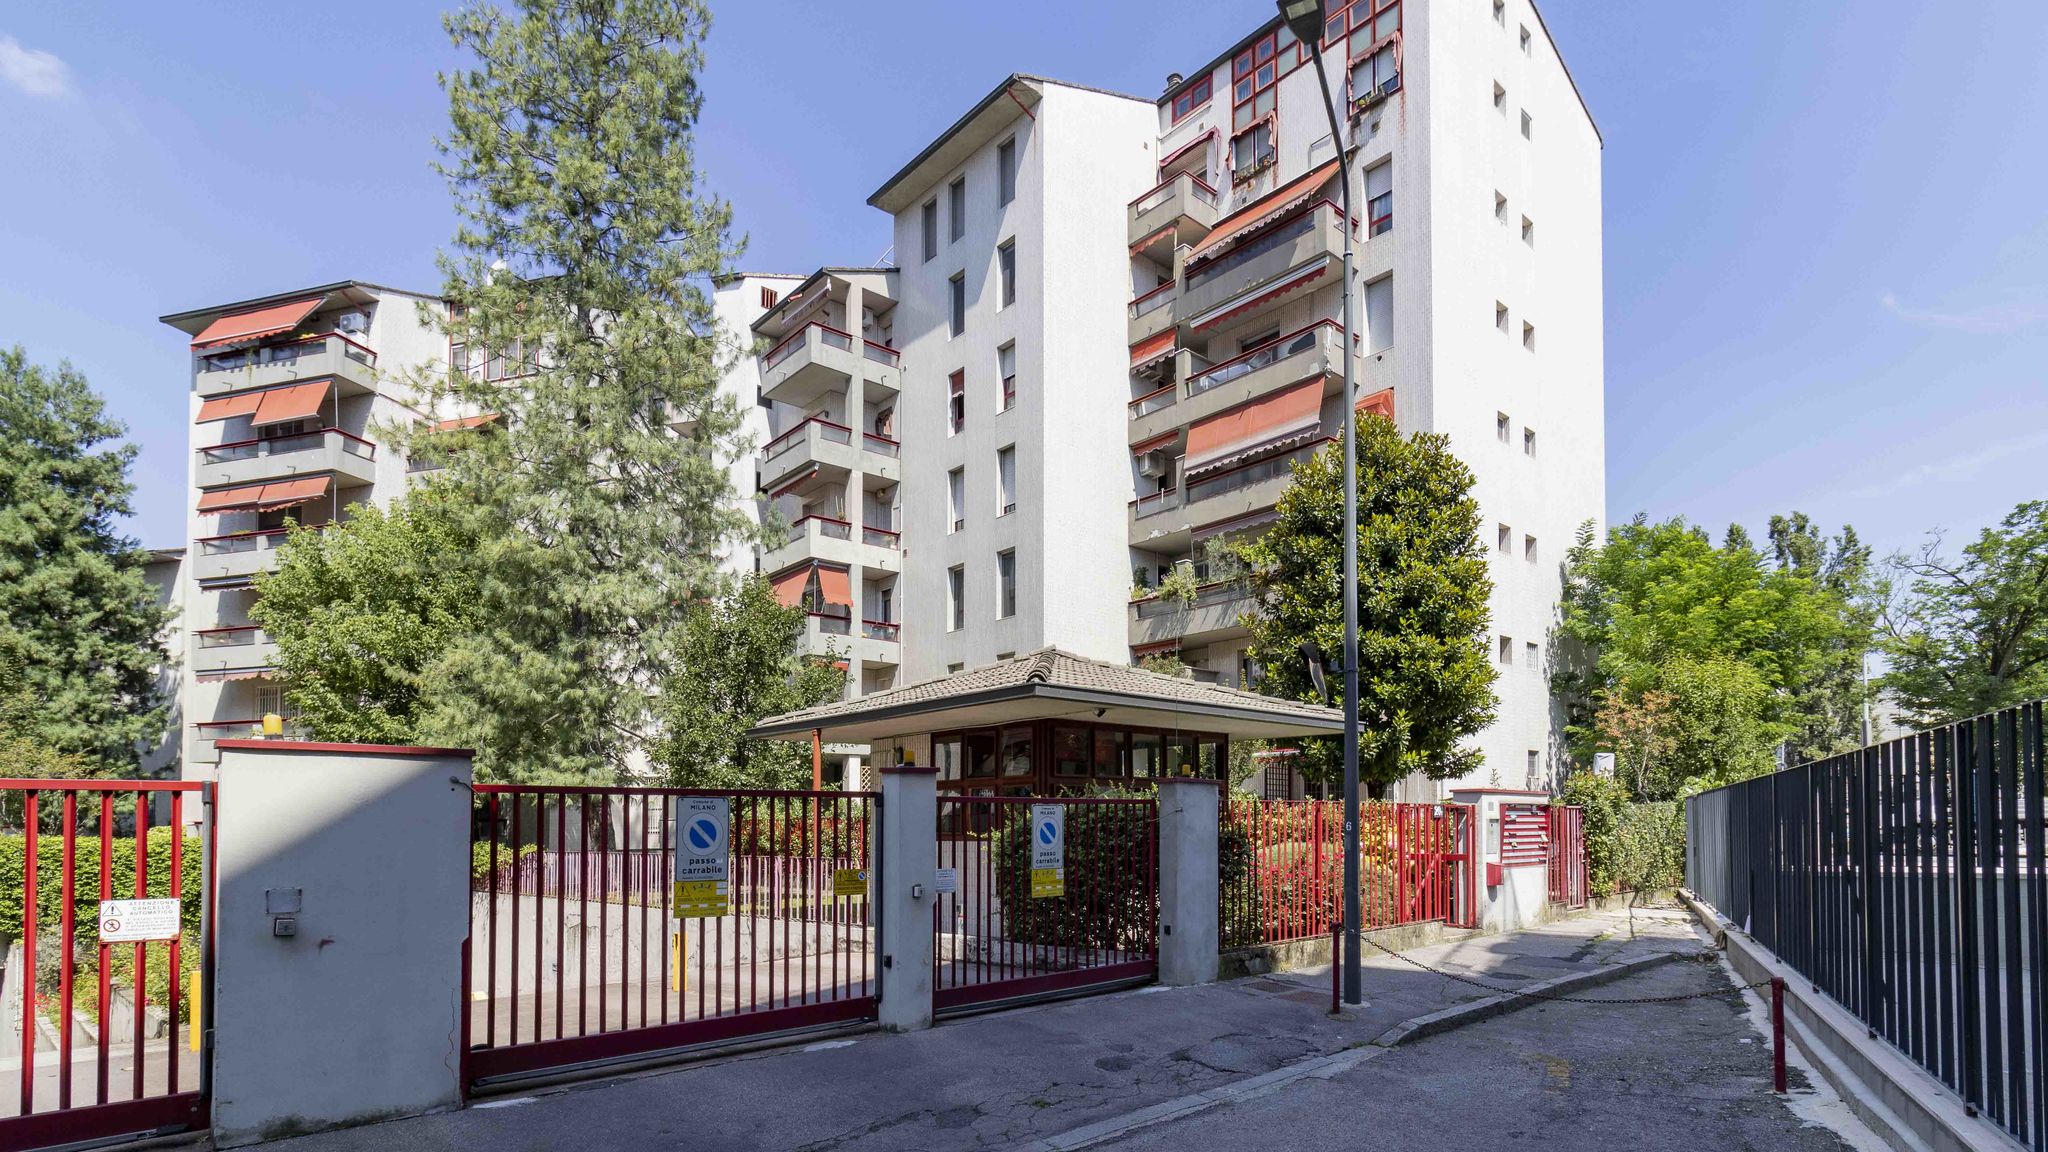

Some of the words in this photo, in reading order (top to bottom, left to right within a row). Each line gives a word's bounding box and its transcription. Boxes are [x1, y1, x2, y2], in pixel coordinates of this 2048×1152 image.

[1345, 821, 1352, 831] 6
[689, 858, 716, 866] passo
[1036, 857, 1060, 865] carrabile
[682, 866, 722, 874] carrabile
